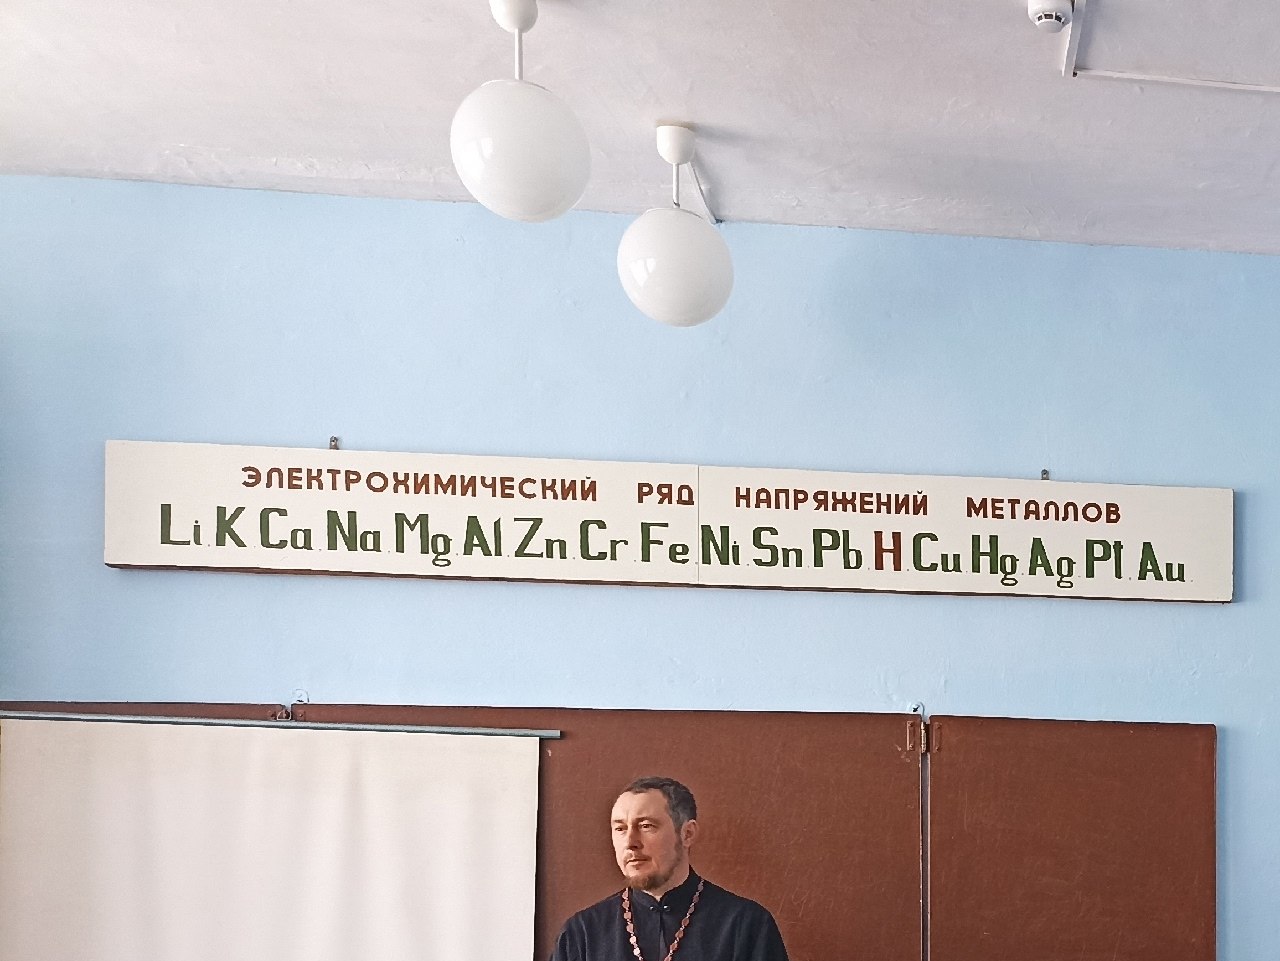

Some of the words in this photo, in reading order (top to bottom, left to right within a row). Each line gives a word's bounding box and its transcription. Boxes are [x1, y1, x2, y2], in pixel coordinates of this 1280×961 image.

[241, 465, 598, 502] ЭЛЕКТРОХИМИЧЕСКИЙ
[637, 482, 695, 506] РЯД
[735, 486, 928, 516] НАПРЯЖЕНИЙ
[966, 496, 1121, 524] МЕТАЛЛОВ
[160, 503, 203, 546] Li
[215, 505, 248, 548] K
[259, 507, 314, 551] Ca
[326, 509, 382, 553] Na
[394, 512, 453, 568] Mg
[513, 517, 568, 560] Zn
[579, 519, 629, 561] Cr
[640, 521, 690, 565] Fe
[700, 524, 741, 566] Ni
[752, 526, 803, 568] Sn
[812, 528, 863, 570] Pb
[873, 530, 902, 572] H
[912, 532, 963, 573] Cu
[971, 534, 1020, 587] Hg
[1028, 536, 1077, 589] Ag
[1137, 541, 1186, 583] Au
